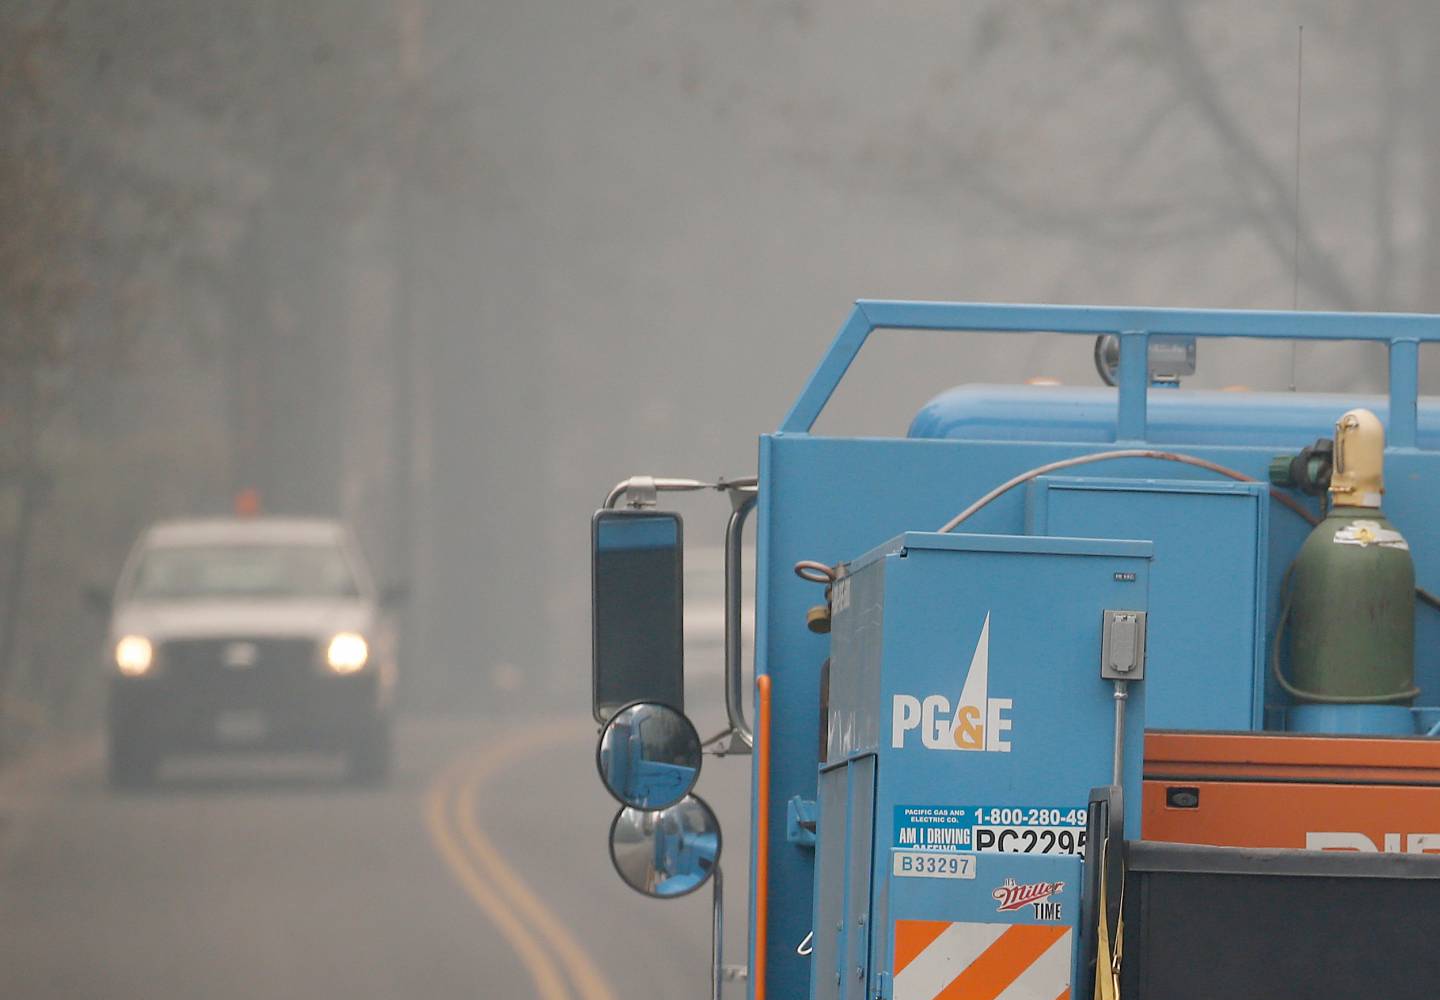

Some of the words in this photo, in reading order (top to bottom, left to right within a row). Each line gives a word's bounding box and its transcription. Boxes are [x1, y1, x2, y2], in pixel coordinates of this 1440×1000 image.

[892, 694, 1013, 752] PG&E
[904, 808, 932, 816] PACIFIC
[949, 809, 966, 817] AND
[946, 816, 960, 824] CO.
[899, 827, 917, 844] AM
[919, 827, 924, 844] I
[927, 828, 971, 845] DRIVING
[902, 855, 969, 875] B33297
[1033, 902, 1062, 920] TIME
